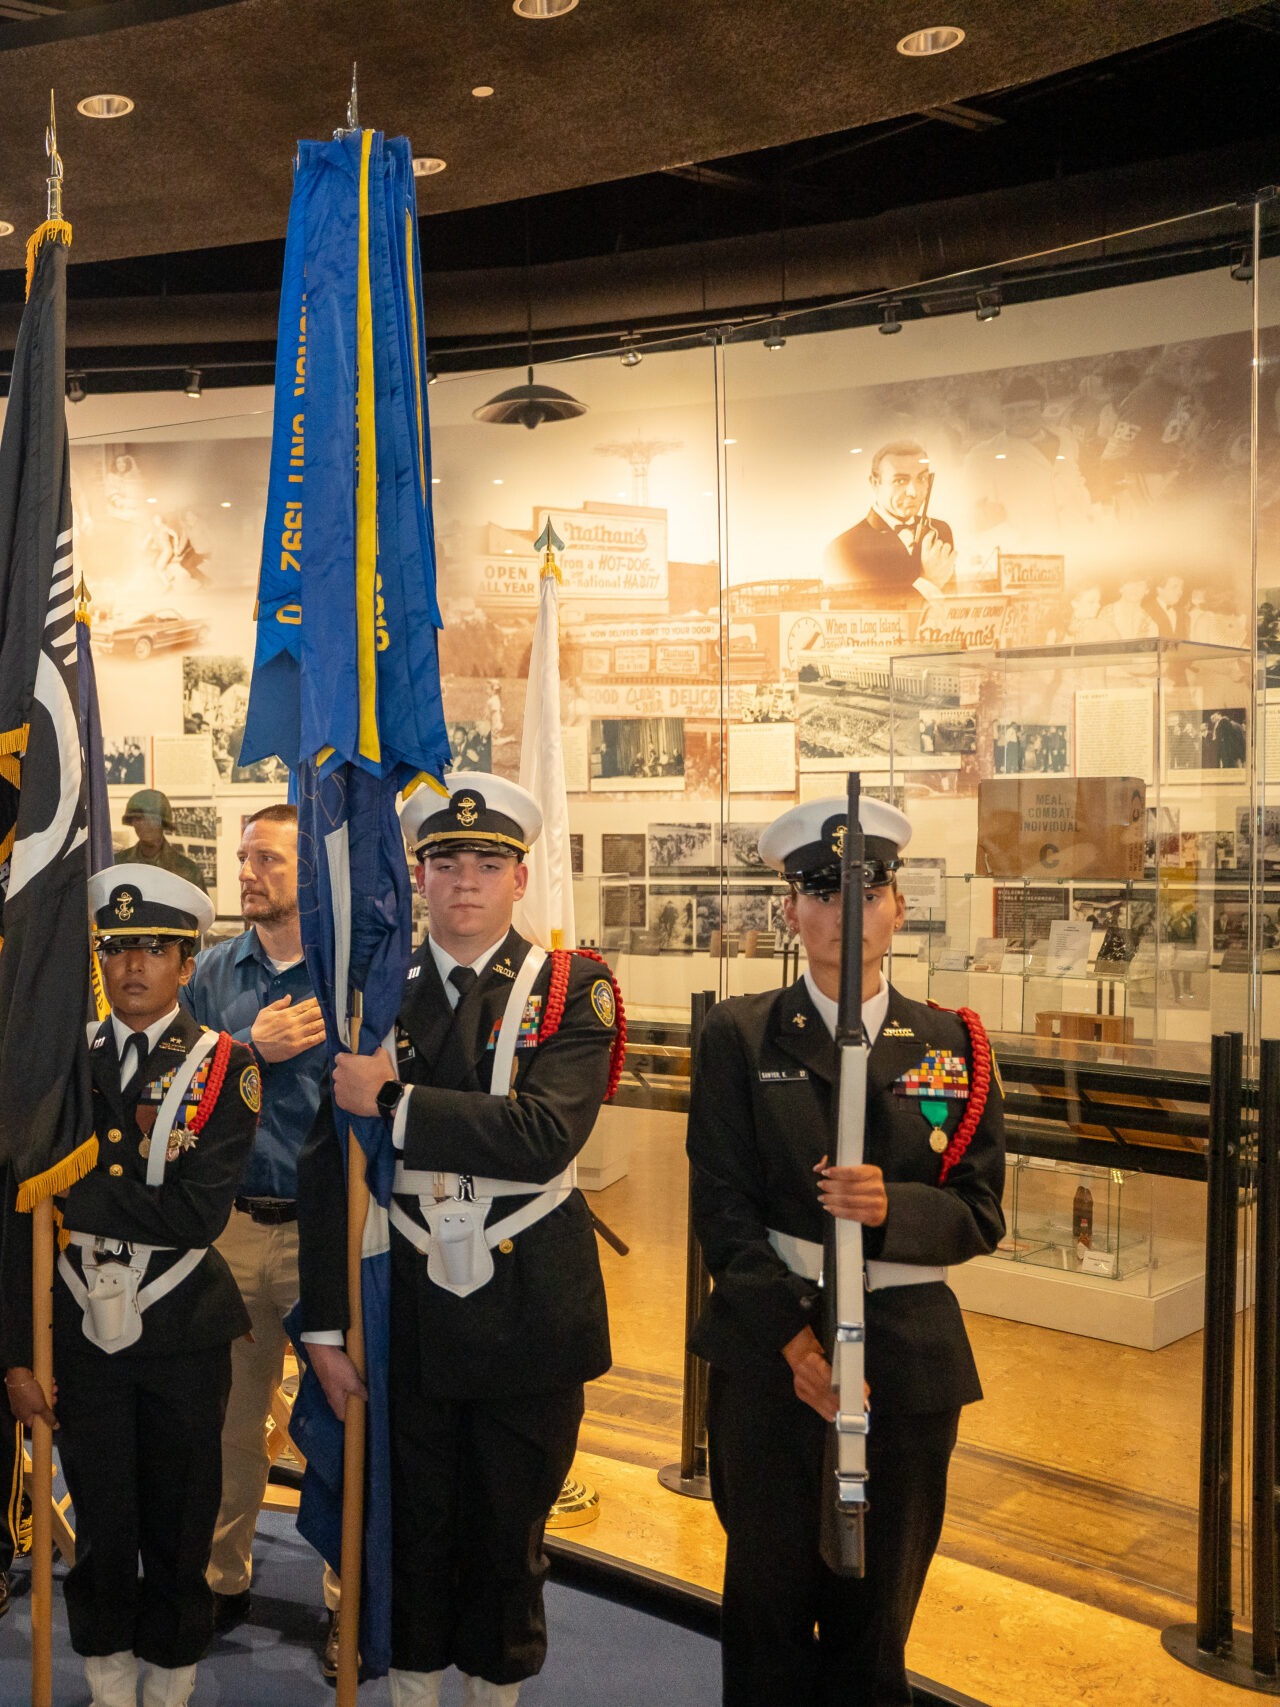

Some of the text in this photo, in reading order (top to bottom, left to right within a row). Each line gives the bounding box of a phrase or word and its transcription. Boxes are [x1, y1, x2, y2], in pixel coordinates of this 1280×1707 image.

[587, 561, 594, 569] a
[485, 565, 528, 580] OPEN
[503, 582, 535, 593] YEAR
[825, 618, 848, 634] When
[850, 620, 857, 633] in
[860, 618, 877, 636] Long
[1020, 821, 1080, 833] INDIVIDUAL
[1039, 843, 1060, 869] C
